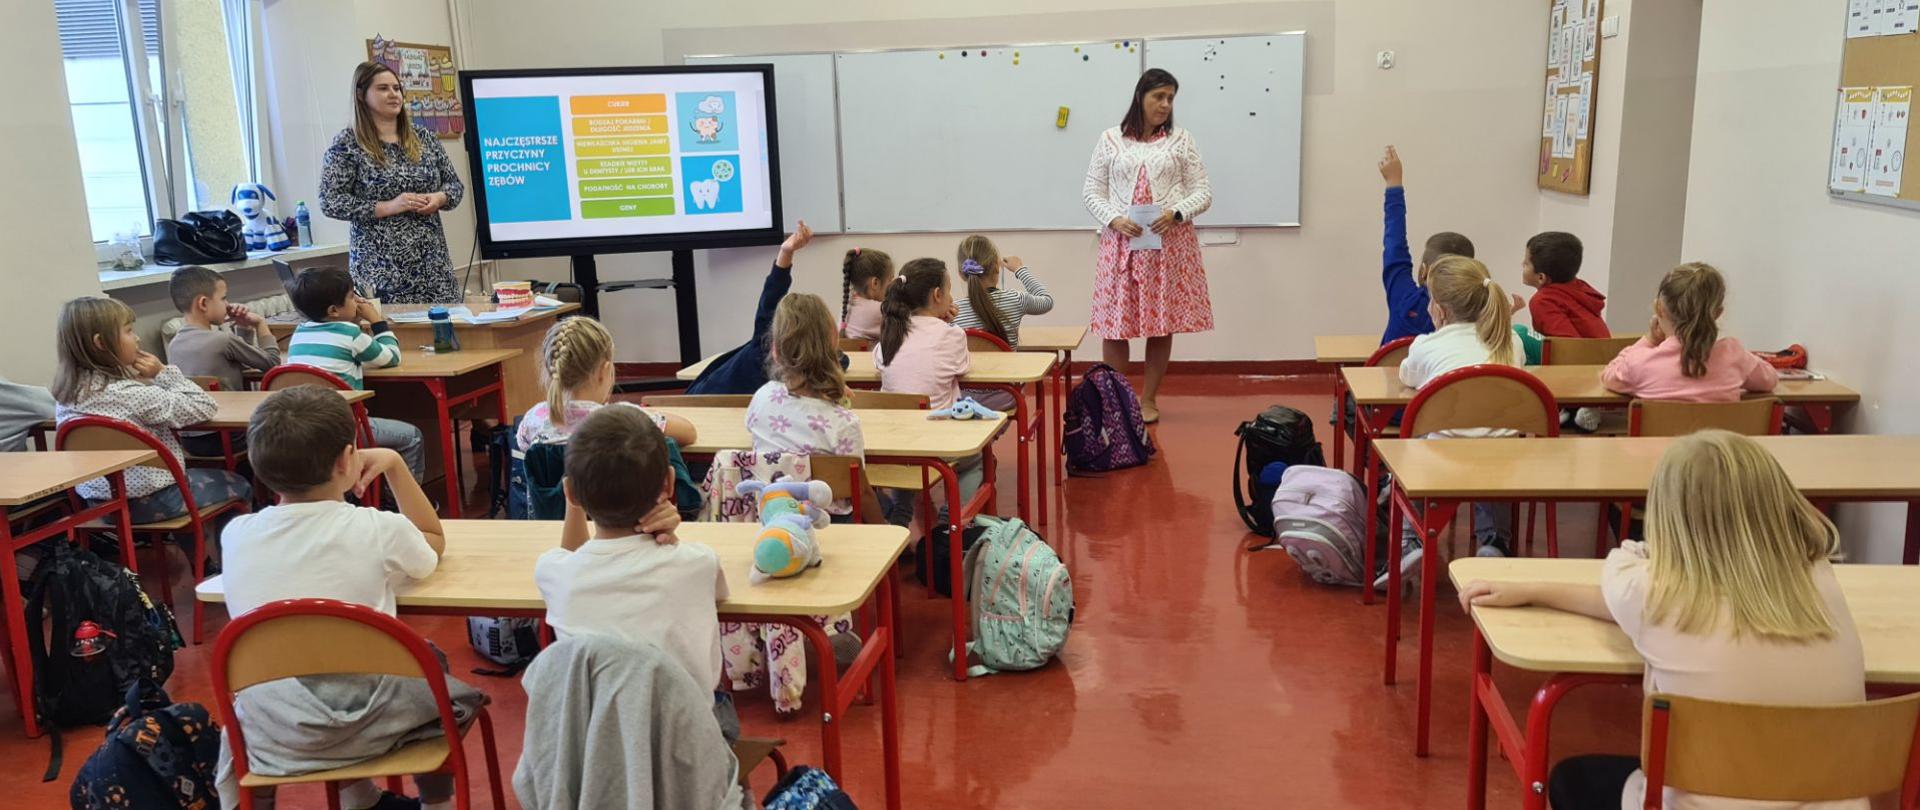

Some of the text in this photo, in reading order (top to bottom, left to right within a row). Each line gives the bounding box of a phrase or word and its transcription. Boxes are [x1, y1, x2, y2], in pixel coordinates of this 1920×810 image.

[484, 135, 558, 147] NAJCZĘSTRSZE
[486, 149, 545, 160] PRZYCZYNY
[487, 161, 550, 173] PROCHNICY
[488, 174, 525, 187] ZĘBÓW
